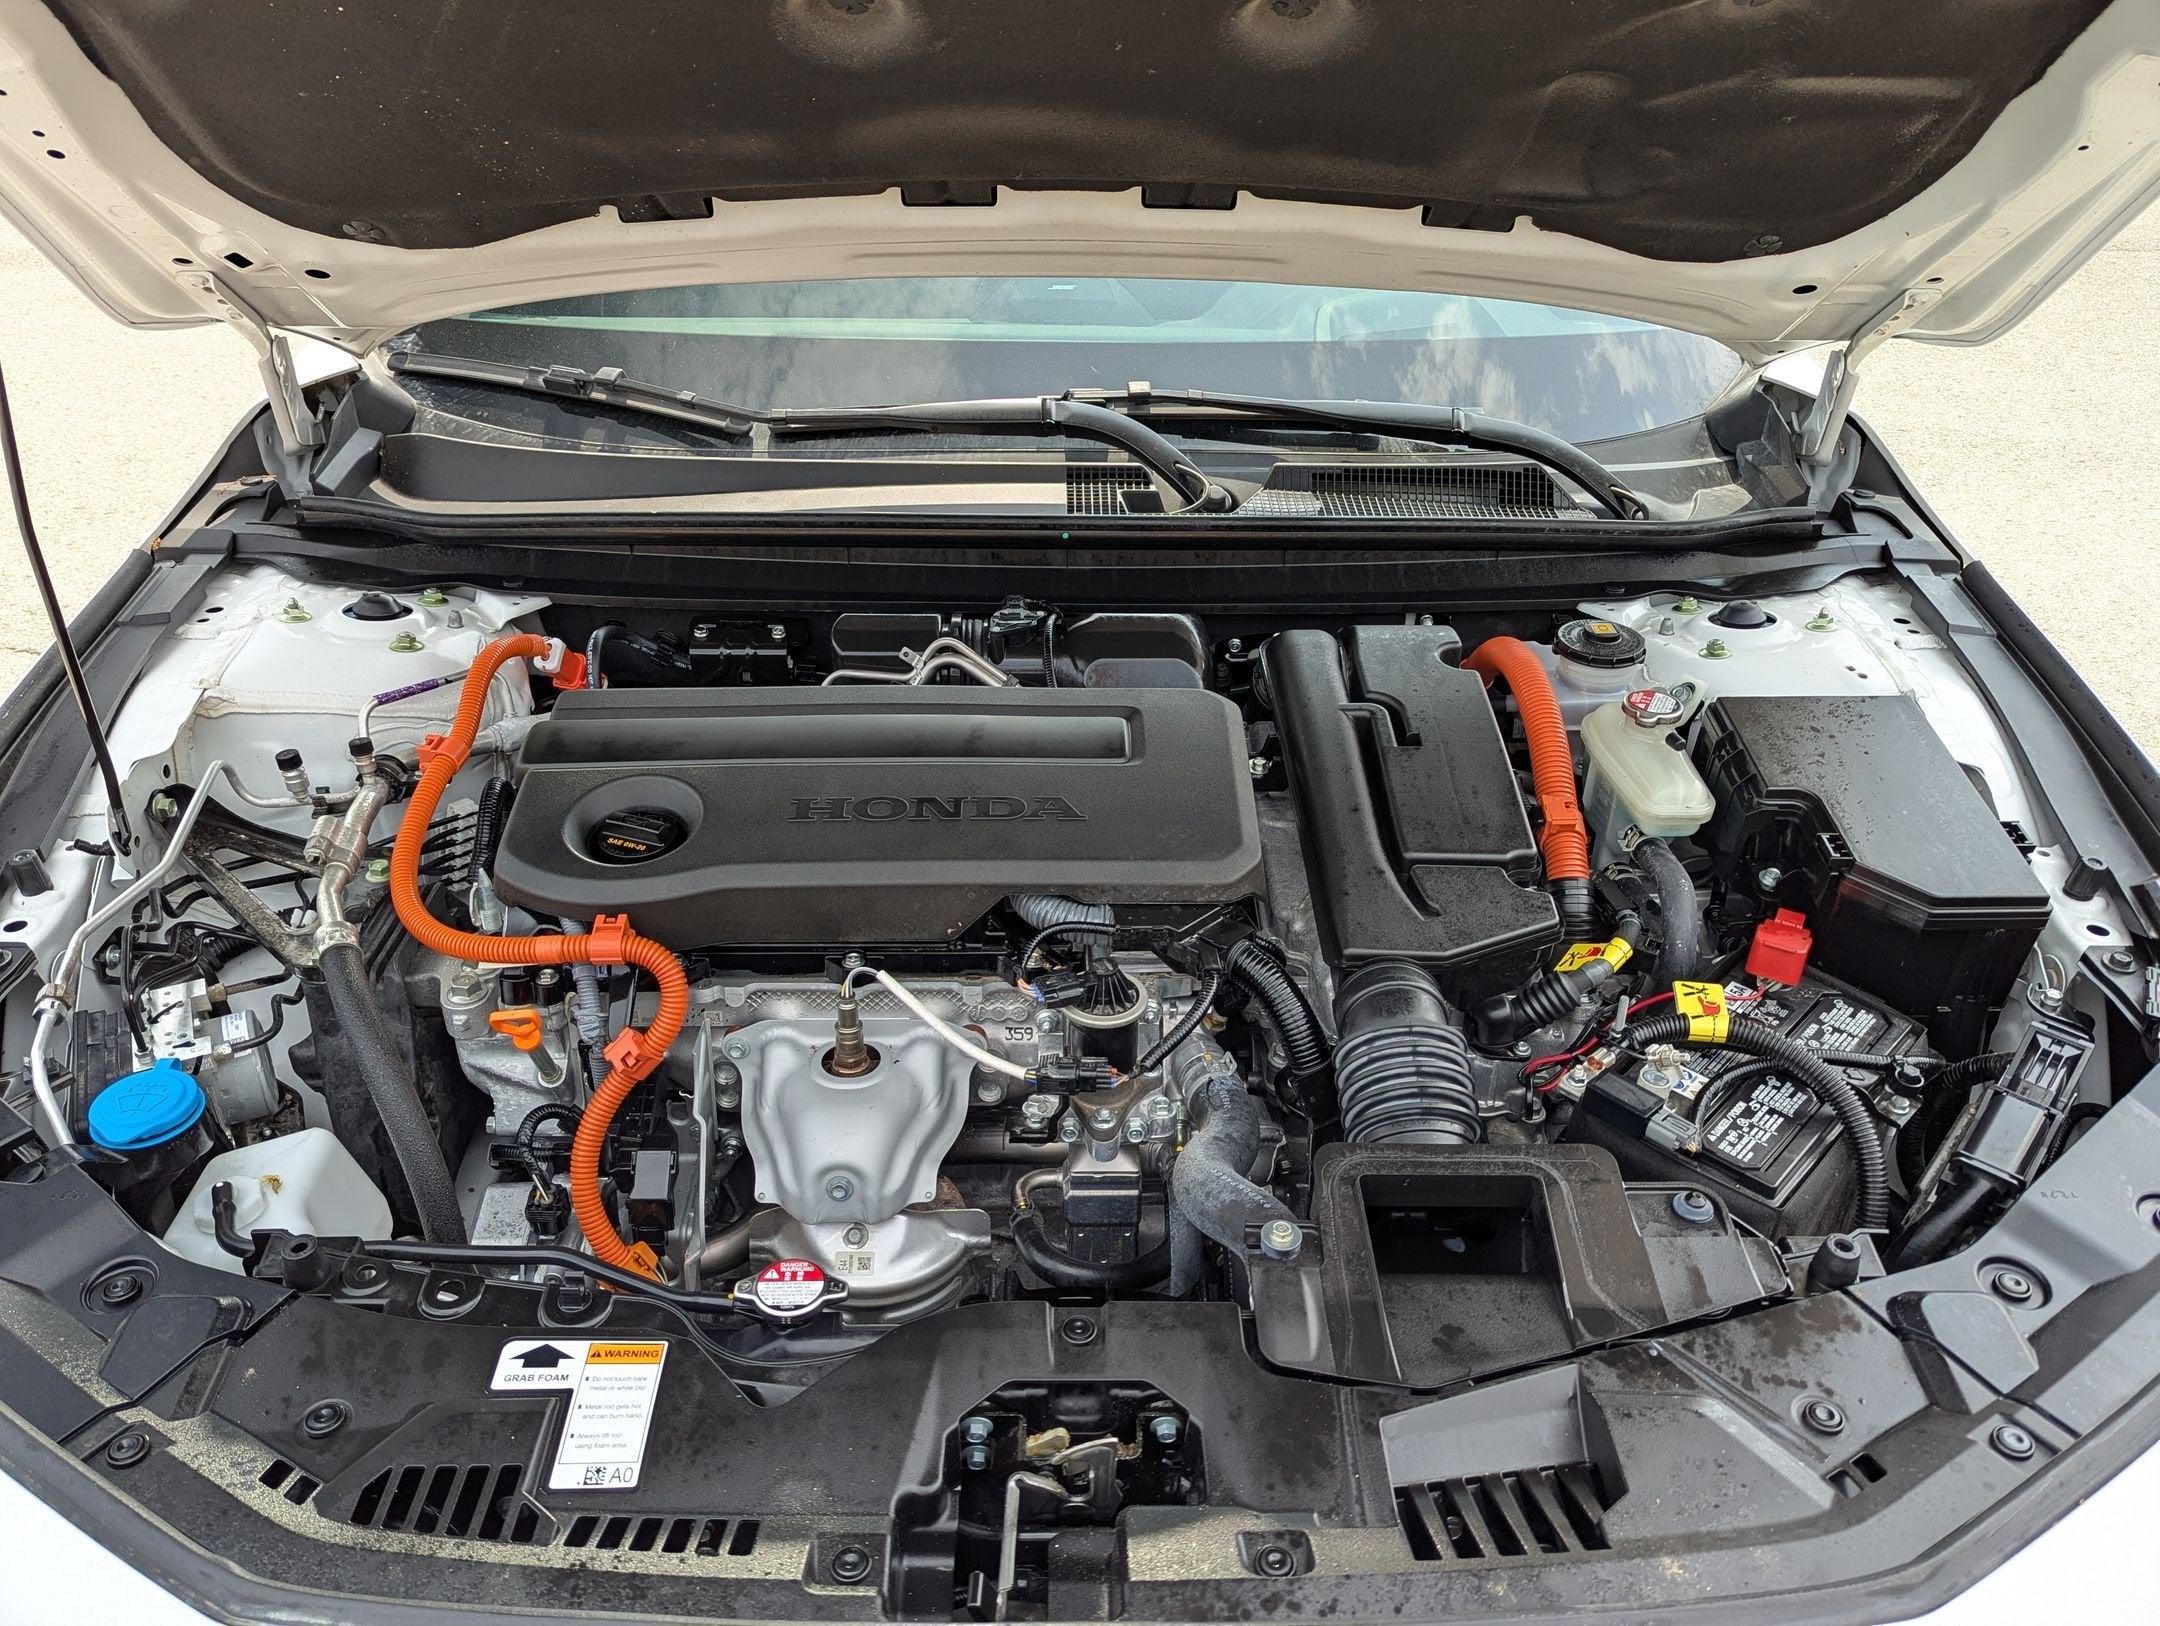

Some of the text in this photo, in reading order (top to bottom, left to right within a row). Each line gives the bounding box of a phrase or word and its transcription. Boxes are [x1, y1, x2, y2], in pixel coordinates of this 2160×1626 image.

[787, 796, 1088, 822] HONDA
[607, 838, 647, 851] SAE 0W-20
[1004, 1026, 1034, 1041] 359
[604, 1350, 660, 1358] WARNING
[503, 1374, 570, 1382] GRAB FOAM
